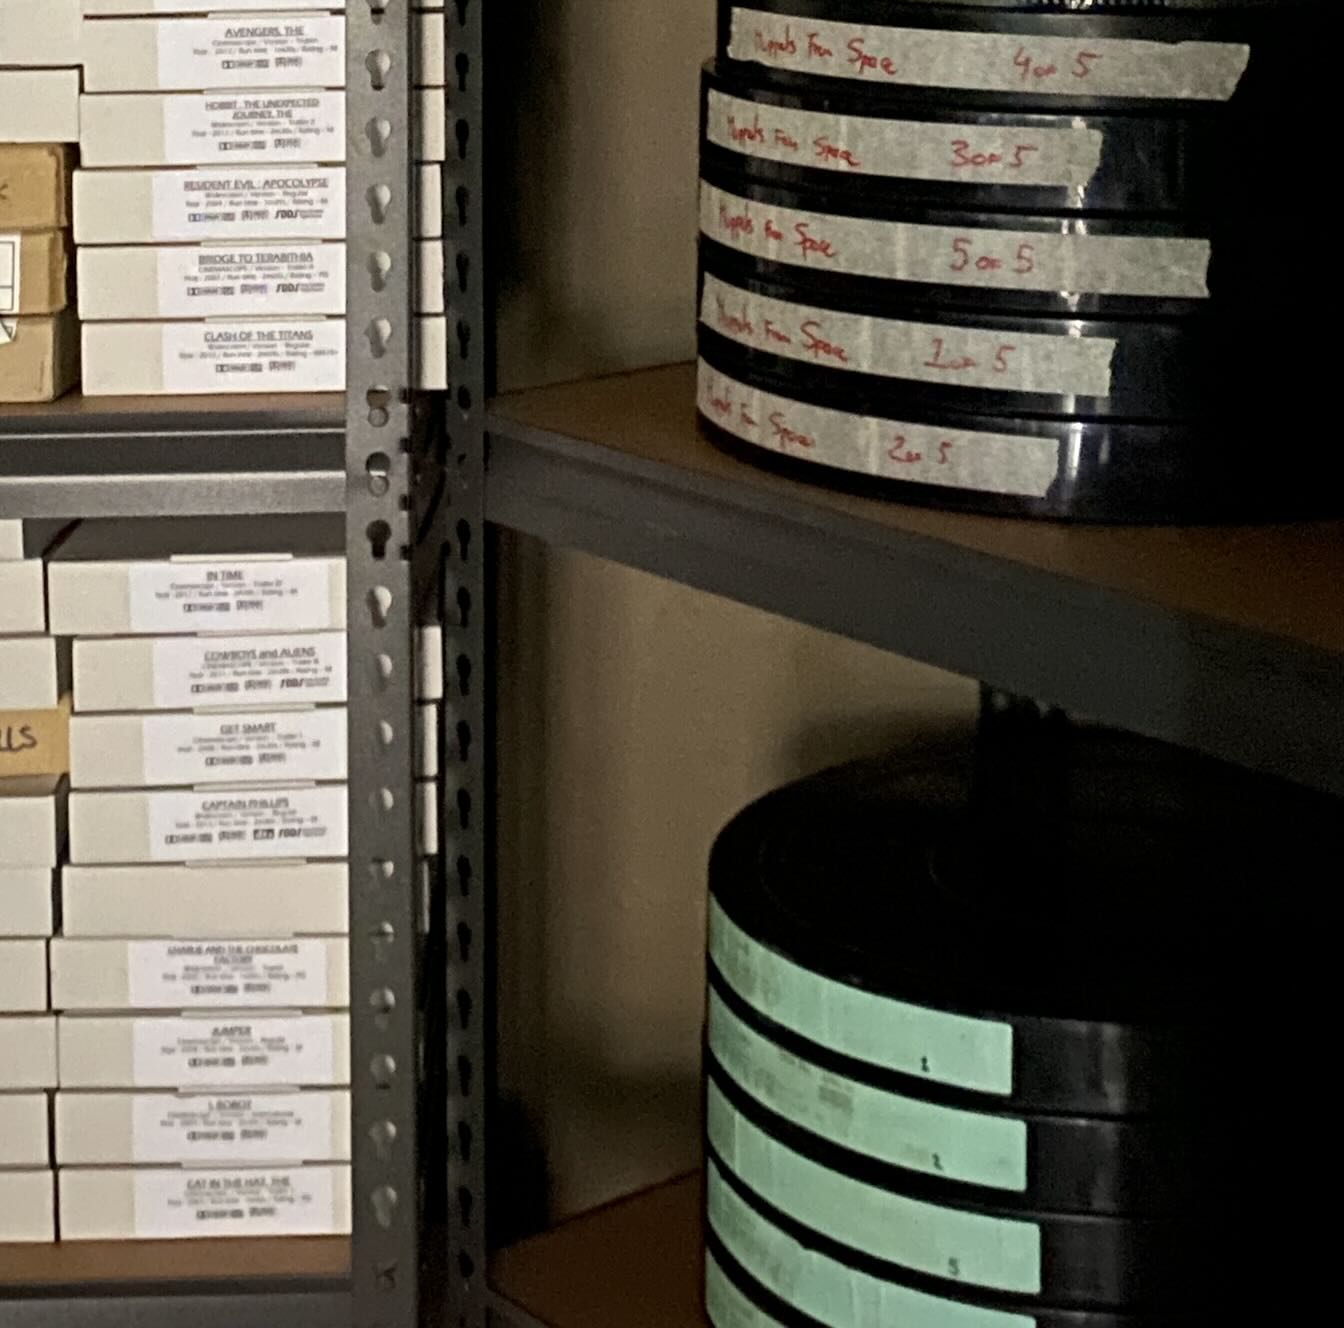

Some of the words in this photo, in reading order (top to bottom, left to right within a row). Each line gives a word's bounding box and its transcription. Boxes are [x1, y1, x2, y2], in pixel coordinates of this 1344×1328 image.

[1013, 48, 1032, 77] 4
[1072, 51, 1103, 78] 5
[950, 140, 970, 168] 3
[1010, 146, 1038, 168] 5
[184, 179, 229, 190] RESIDENT
[198, 253, 236, 264] BRIDGE
[951, 237, 972, 271] 5
[1014, 243, 1035, 274] 5
[204, 331, 238, 340] CLASH
[277, 330, 313, 340] TITANS
[994, 344, 1016, 374] 5
